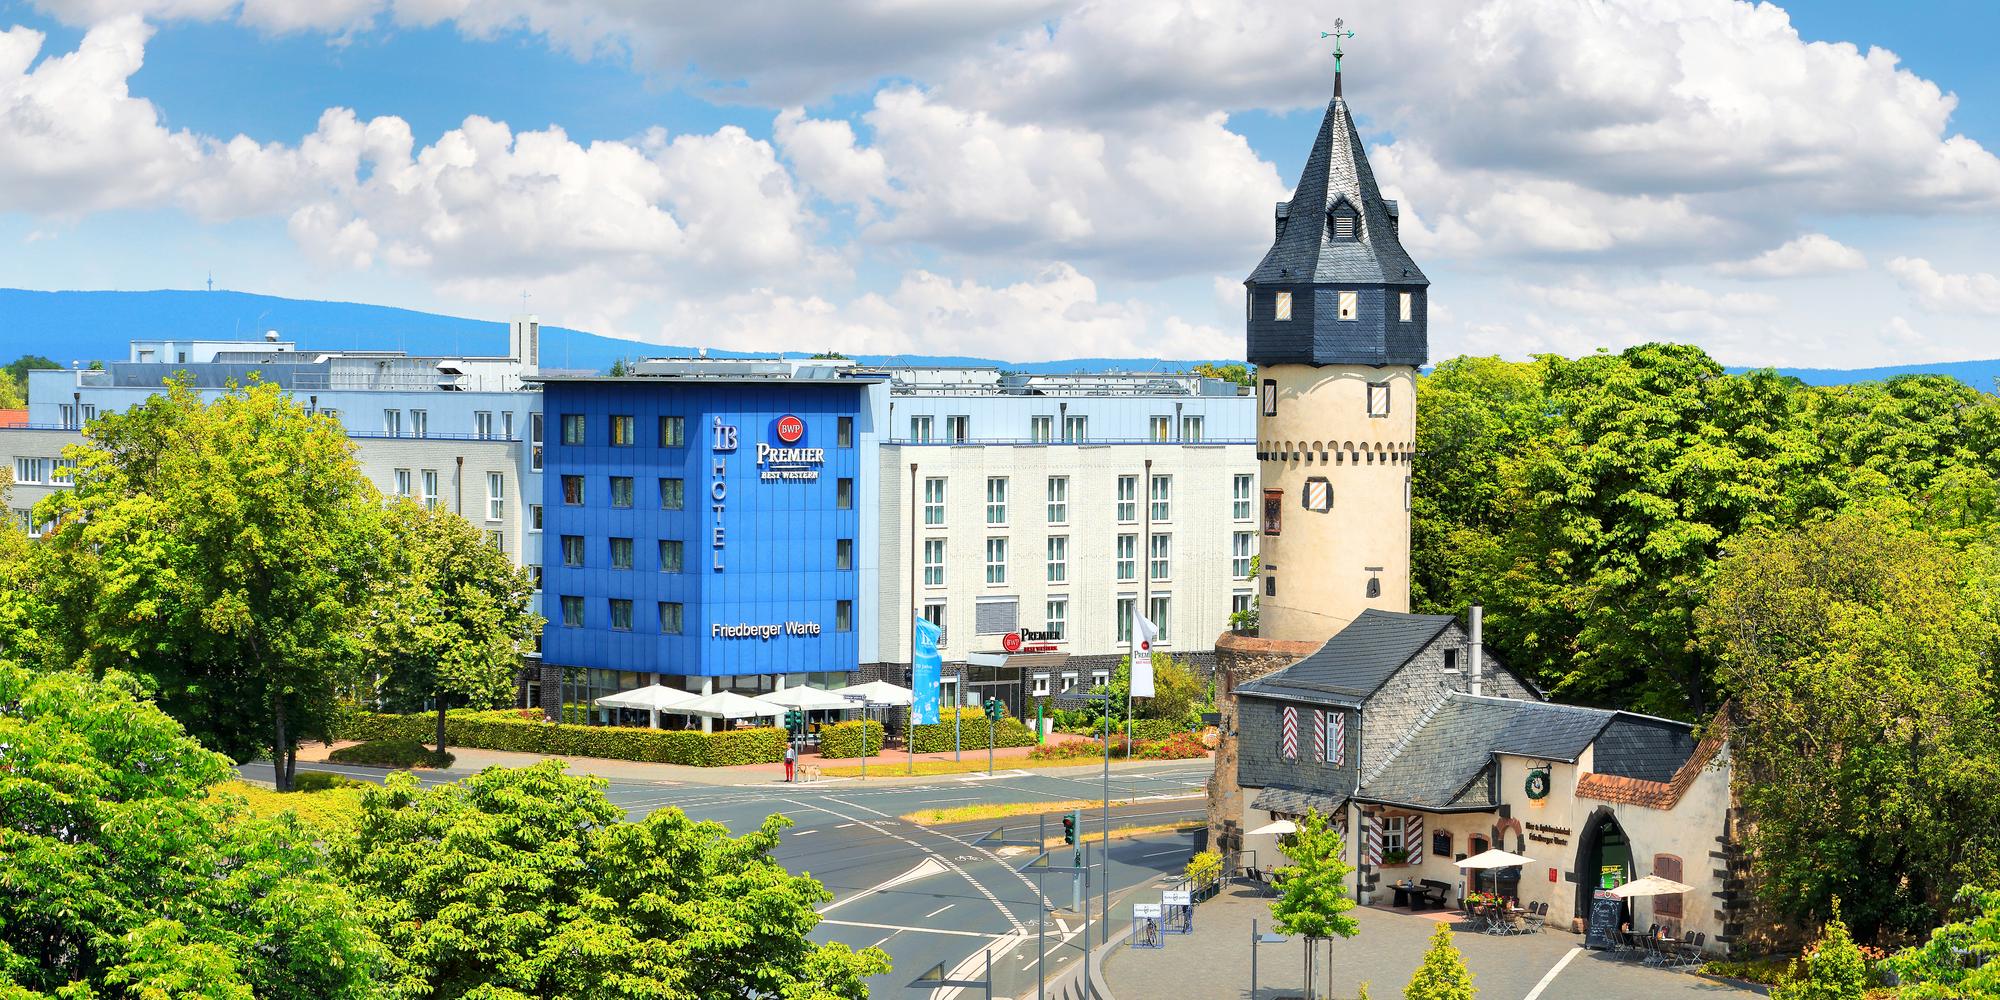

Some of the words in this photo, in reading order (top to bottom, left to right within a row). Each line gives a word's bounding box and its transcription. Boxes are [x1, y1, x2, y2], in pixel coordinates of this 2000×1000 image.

[781, 424, 800, 434] BWP
[756, 442, 825, 464] PREMIER
[761, 471, 781, 479] BEST
[782, 471, 818, 479] WESTERN
[712, 458, 726, 569] HOTEL
[712, 623, 782, 638] Friedberger
[785, 621, 820, 635] Warte
[1021, 628, 1060, 642] PREMIER
